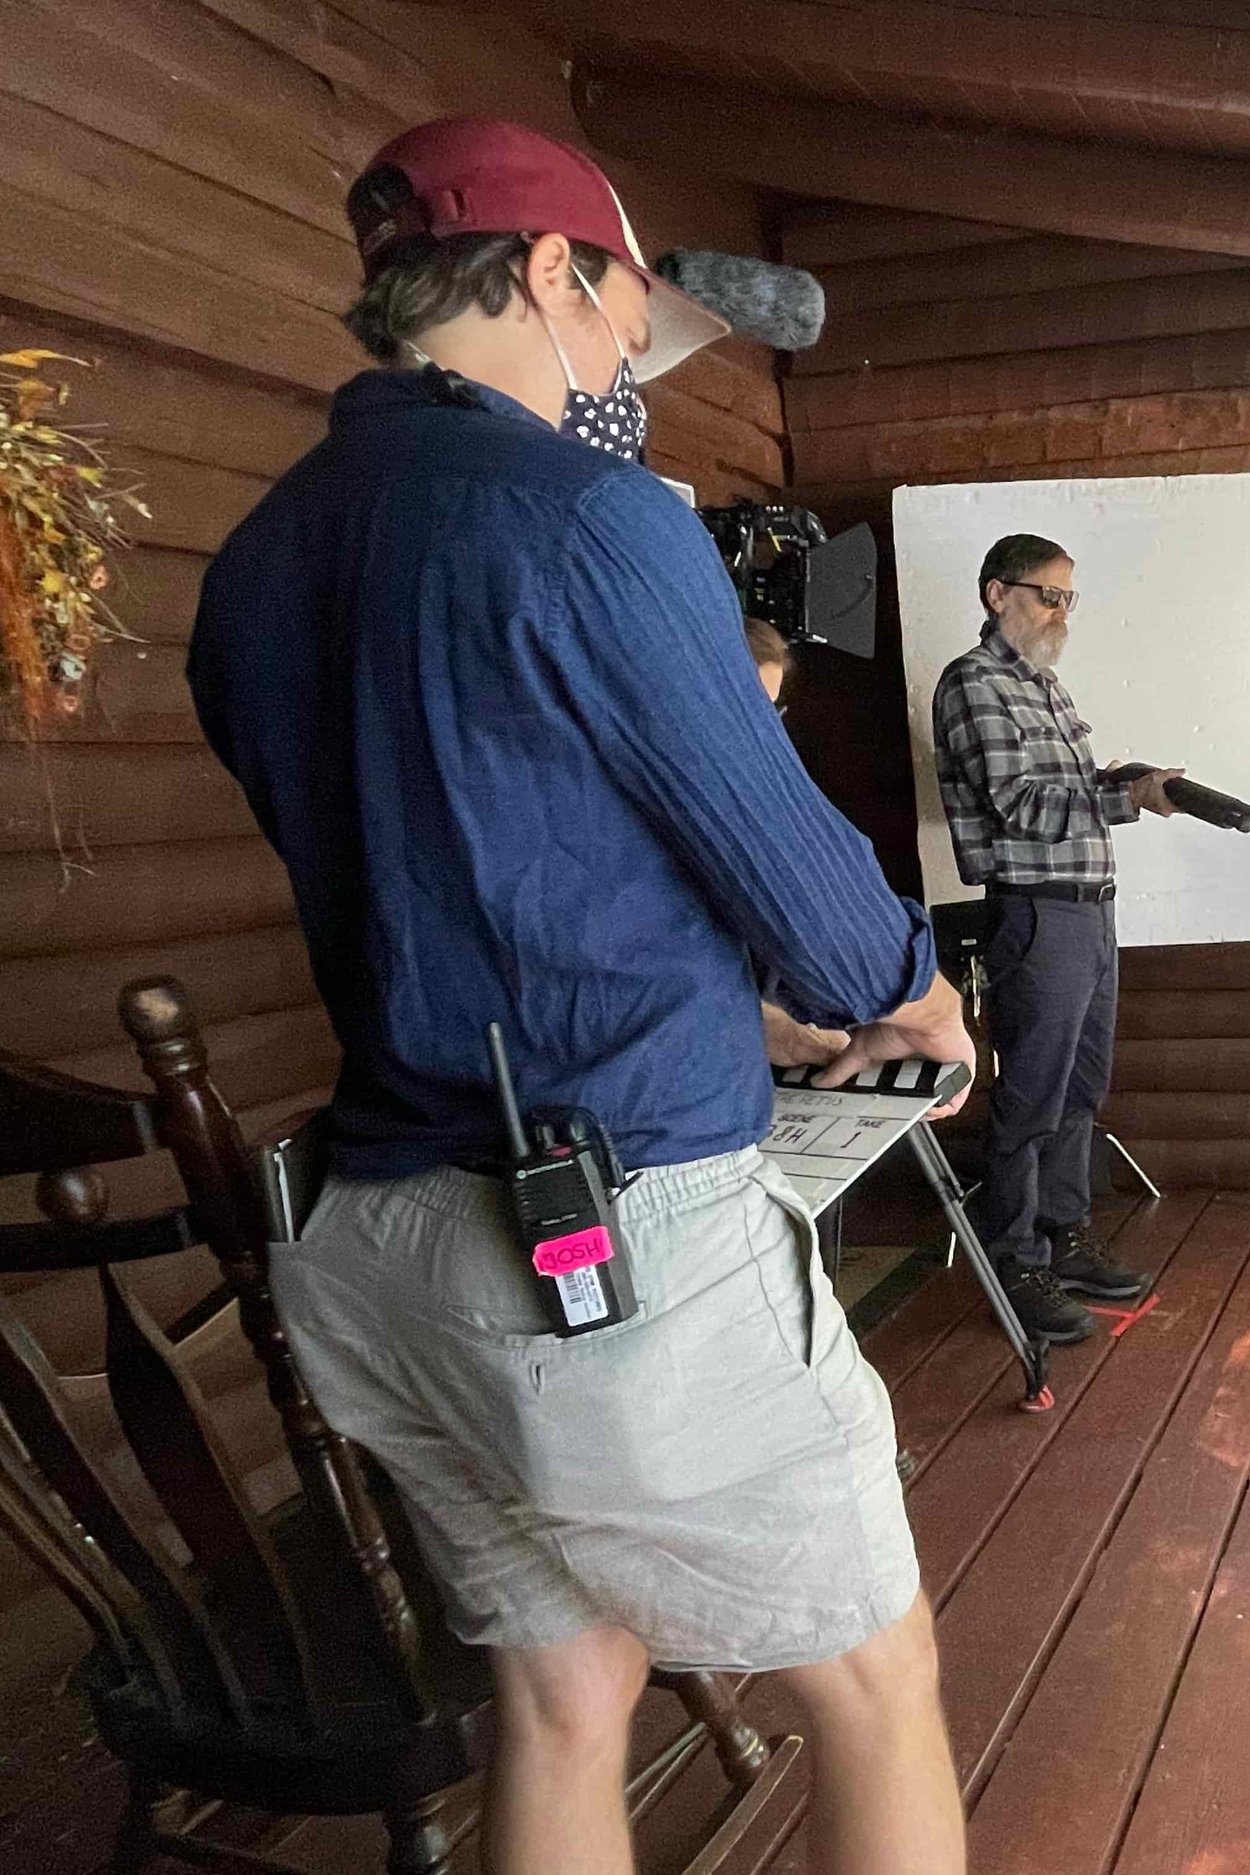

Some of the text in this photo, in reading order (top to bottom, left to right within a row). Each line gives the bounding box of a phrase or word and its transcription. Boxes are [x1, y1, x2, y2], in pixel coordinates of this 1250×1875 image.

[778, 1113, 815, 1123] SCENE
[855, 1119, 886, 1129] TAKE
[841, 1132, 862, 1149] 1
[543, 1238, 600, 1270] JOSH
